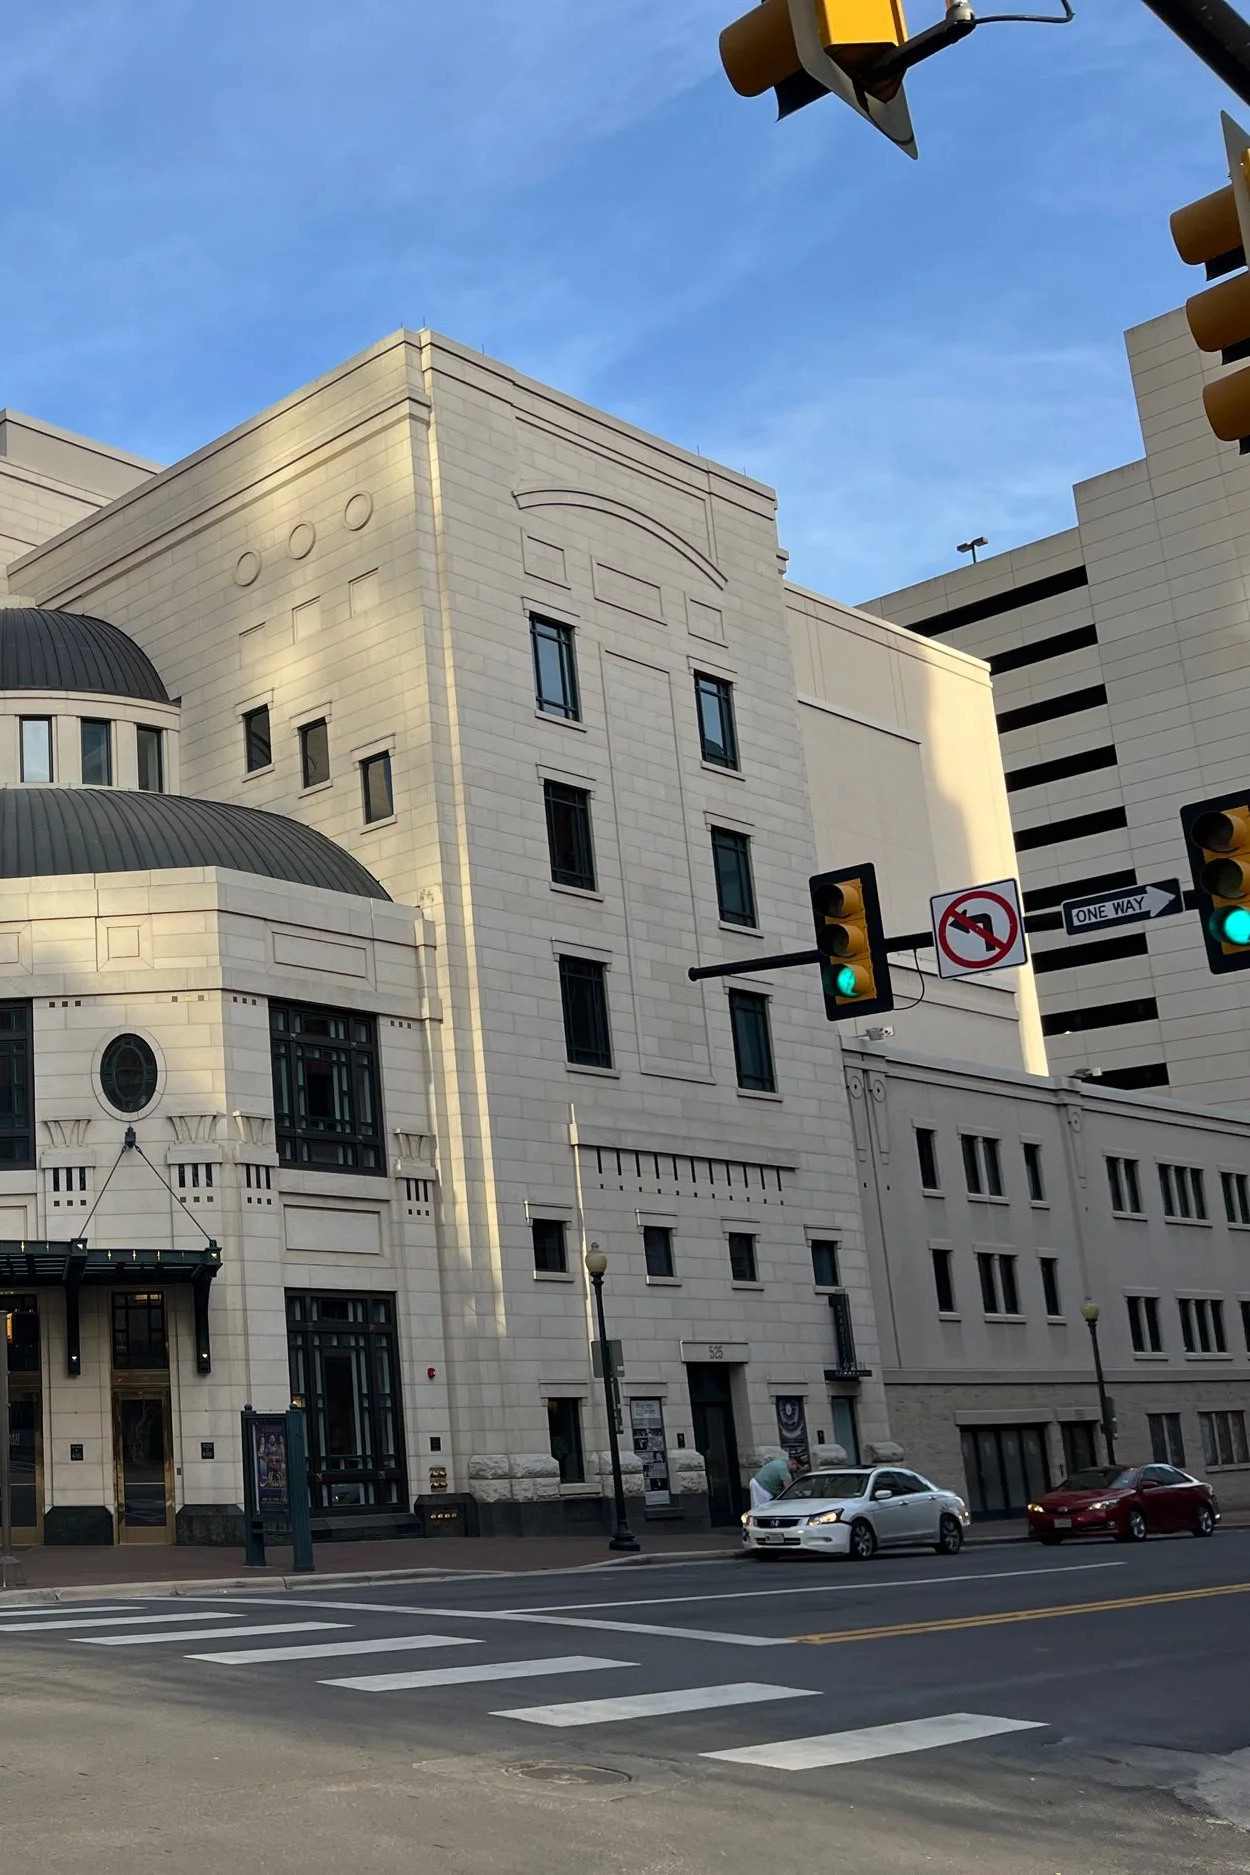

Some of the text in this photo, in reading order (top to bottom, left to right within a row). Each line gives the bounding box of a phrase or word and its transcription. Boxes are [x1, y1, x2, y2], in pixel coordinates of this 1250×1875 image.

[1076, 896, 1144, 922] ONE WAY
[709, 1345, 723, 1359] 525
